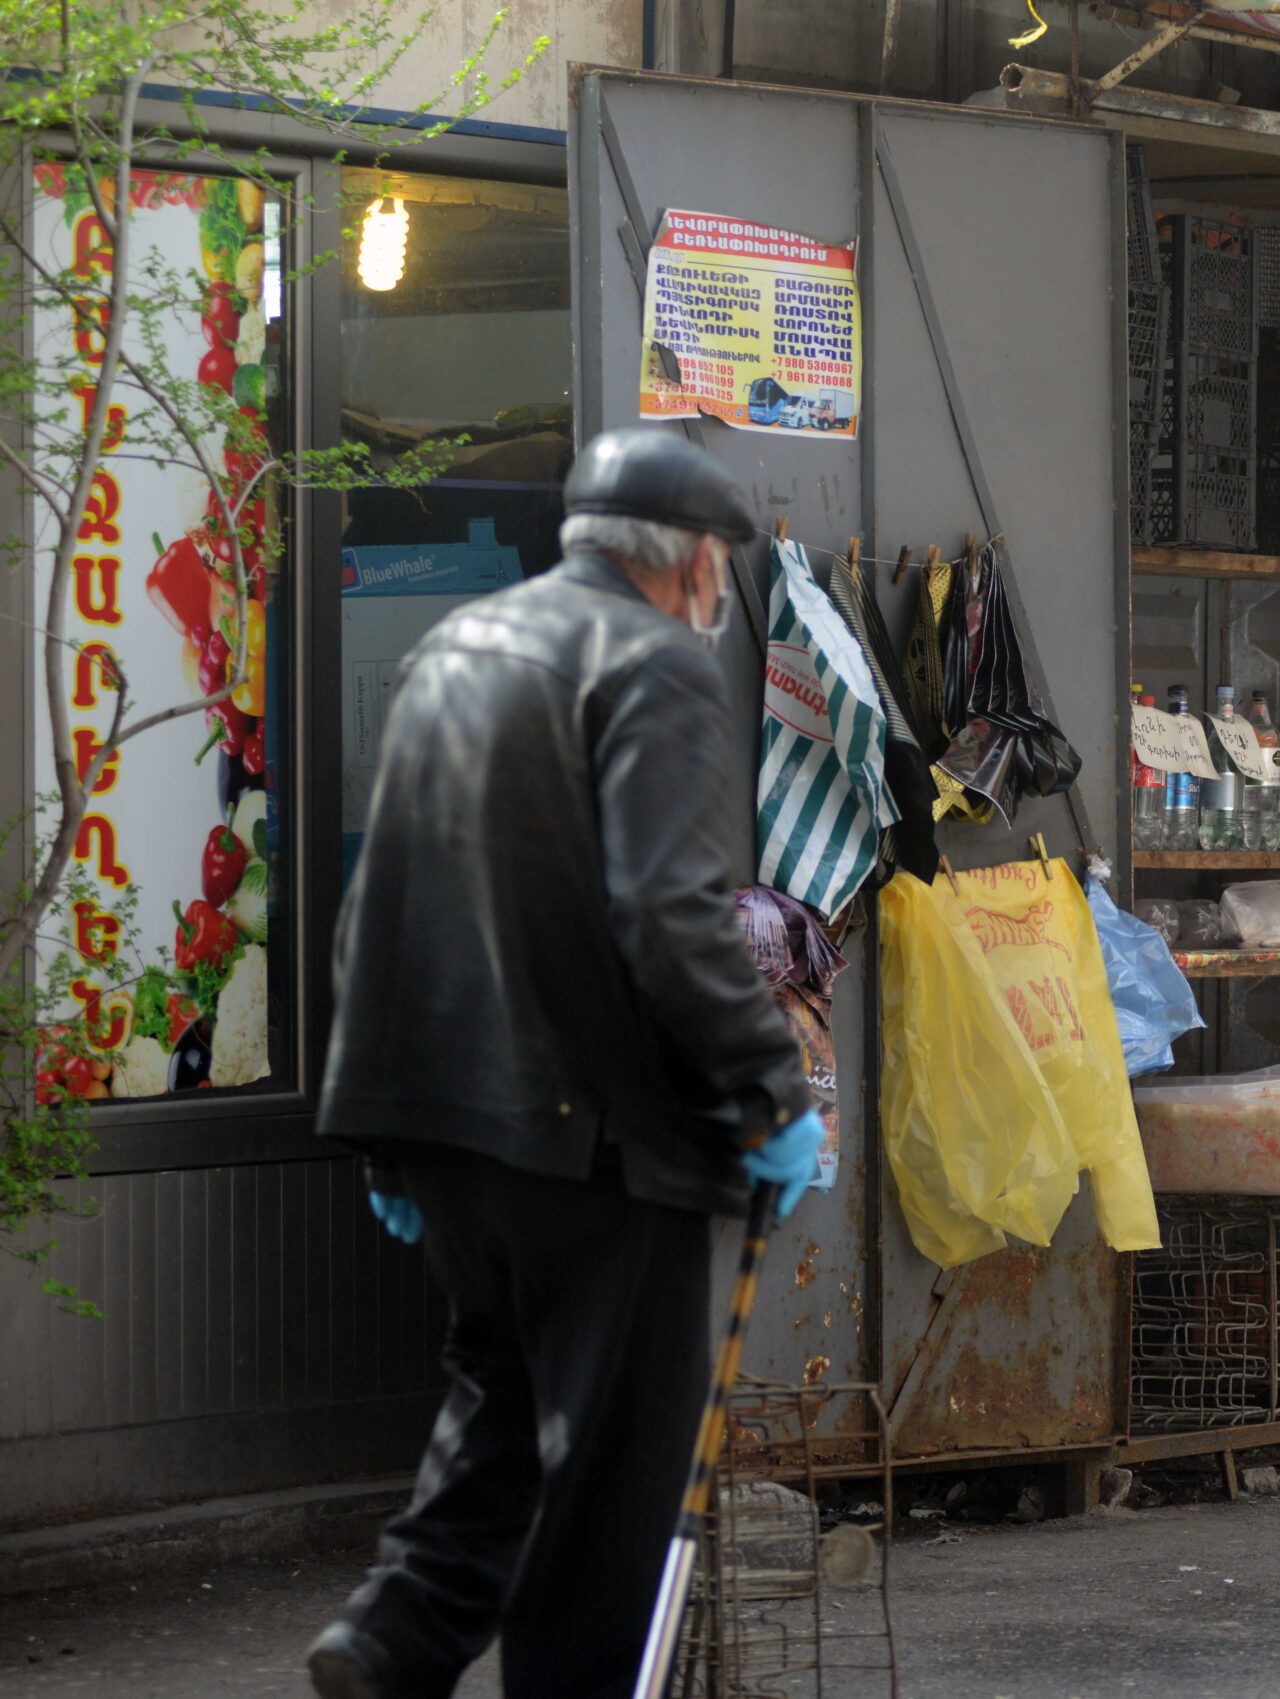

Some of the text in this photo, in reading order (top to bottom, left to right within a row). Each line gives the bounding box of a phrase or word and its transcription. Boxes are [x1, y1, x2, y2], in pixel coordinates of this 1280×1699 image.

[673, 231, 828, 262] ԲԵՌՆԱՓՈԽԱԴՐՈՒՄ
[774, 278, 854, 297] ԲԱԹՈՒՄԻ
[656, 289, 760, 312] ՊՅԱՏԻԳՈՐՍԿ
[774, 291, 854, 311] ԱՐՄԱՎԻՐ
[774, 304, 853, 323] ՌՈՍՏՈՎ
[654, 328, 700, 344] ՍՈՉԻ
[655, 316, 760, 339] ՆԵՎԻՆՈՄԻՍԿ
[773, 318, 853, 336] ՎՈՐՈՆԵԺ
[773, 331, 853, 350] ՄՈՍԿՎԱ
[773, 343, 853, 362] ԱՆԱՊԱ
[716, 363, 735, 376] 105
[771, 356, 853, 374] +7 980 5308967
[715, 375, 735, 388] 099
[771, 370, 853, 388] +7 961 8218088
[361, 554, 433, 586] BlueWhale
[766, 665, 829, 717] tman
